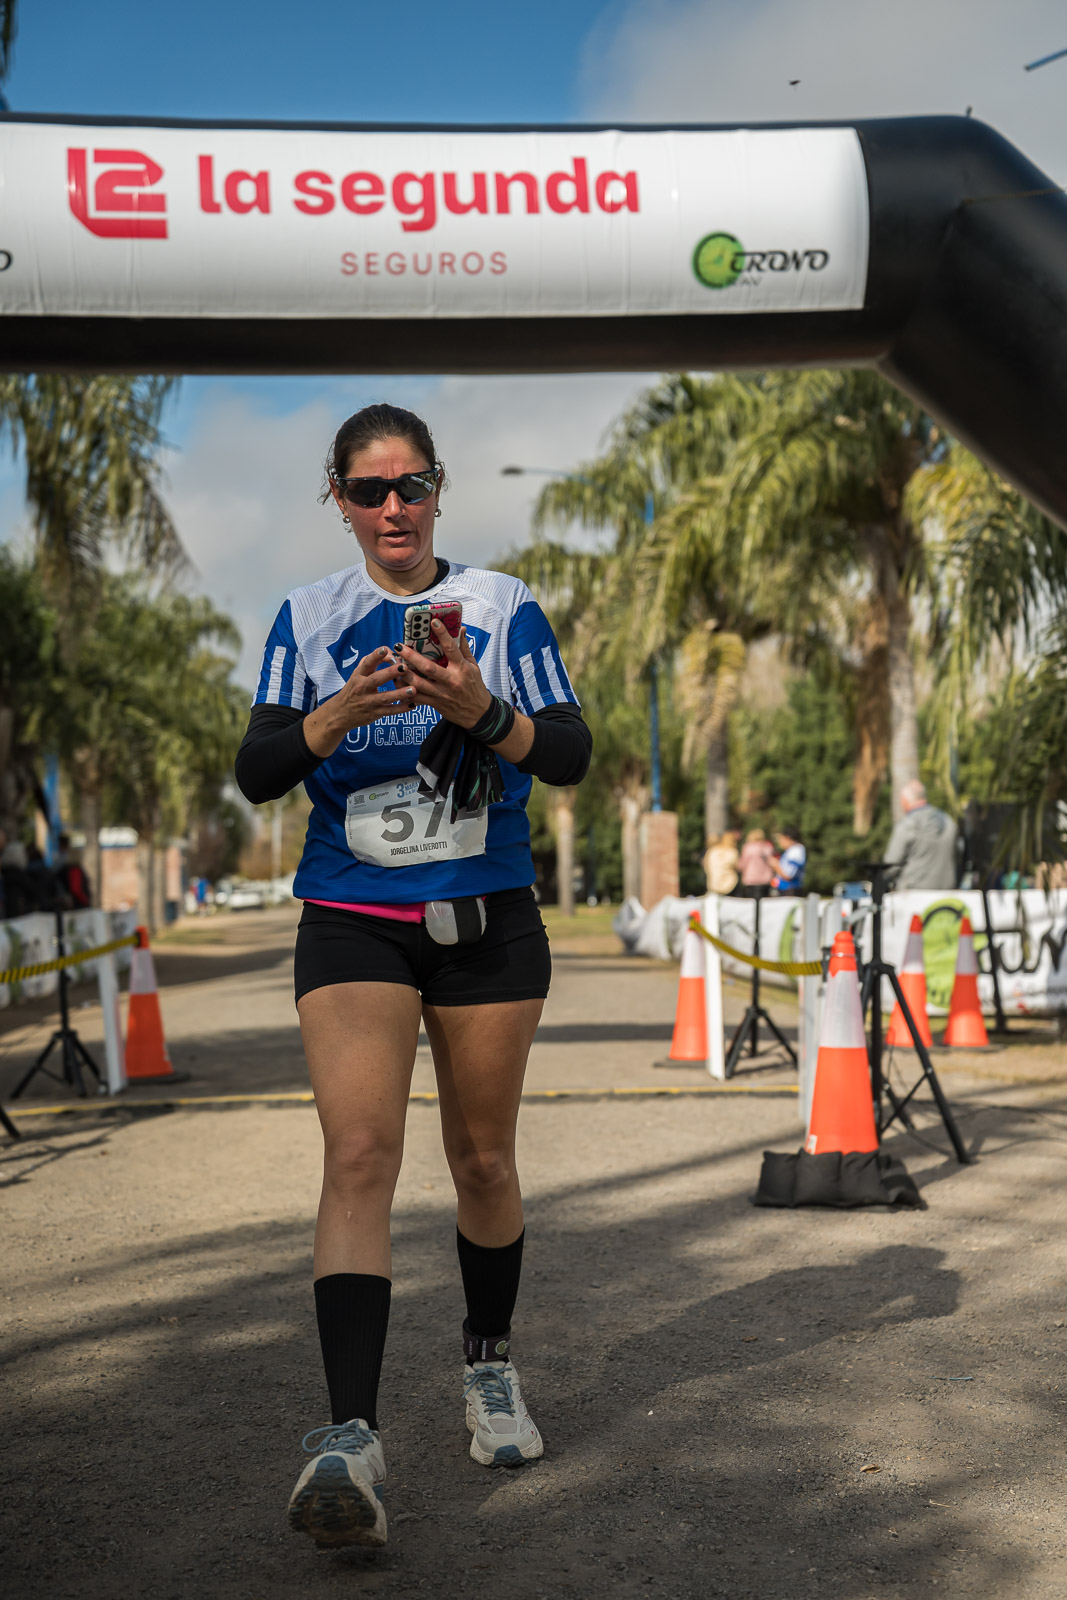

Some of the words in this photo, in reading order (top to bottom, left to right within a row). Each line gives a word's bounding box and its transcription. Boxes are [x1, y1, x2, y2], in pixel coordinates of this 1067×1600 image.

[198, 155, 271, 214] la
[293, 157, 640, 233] segunda
[340, 251, 507, 276] SEGUROS
